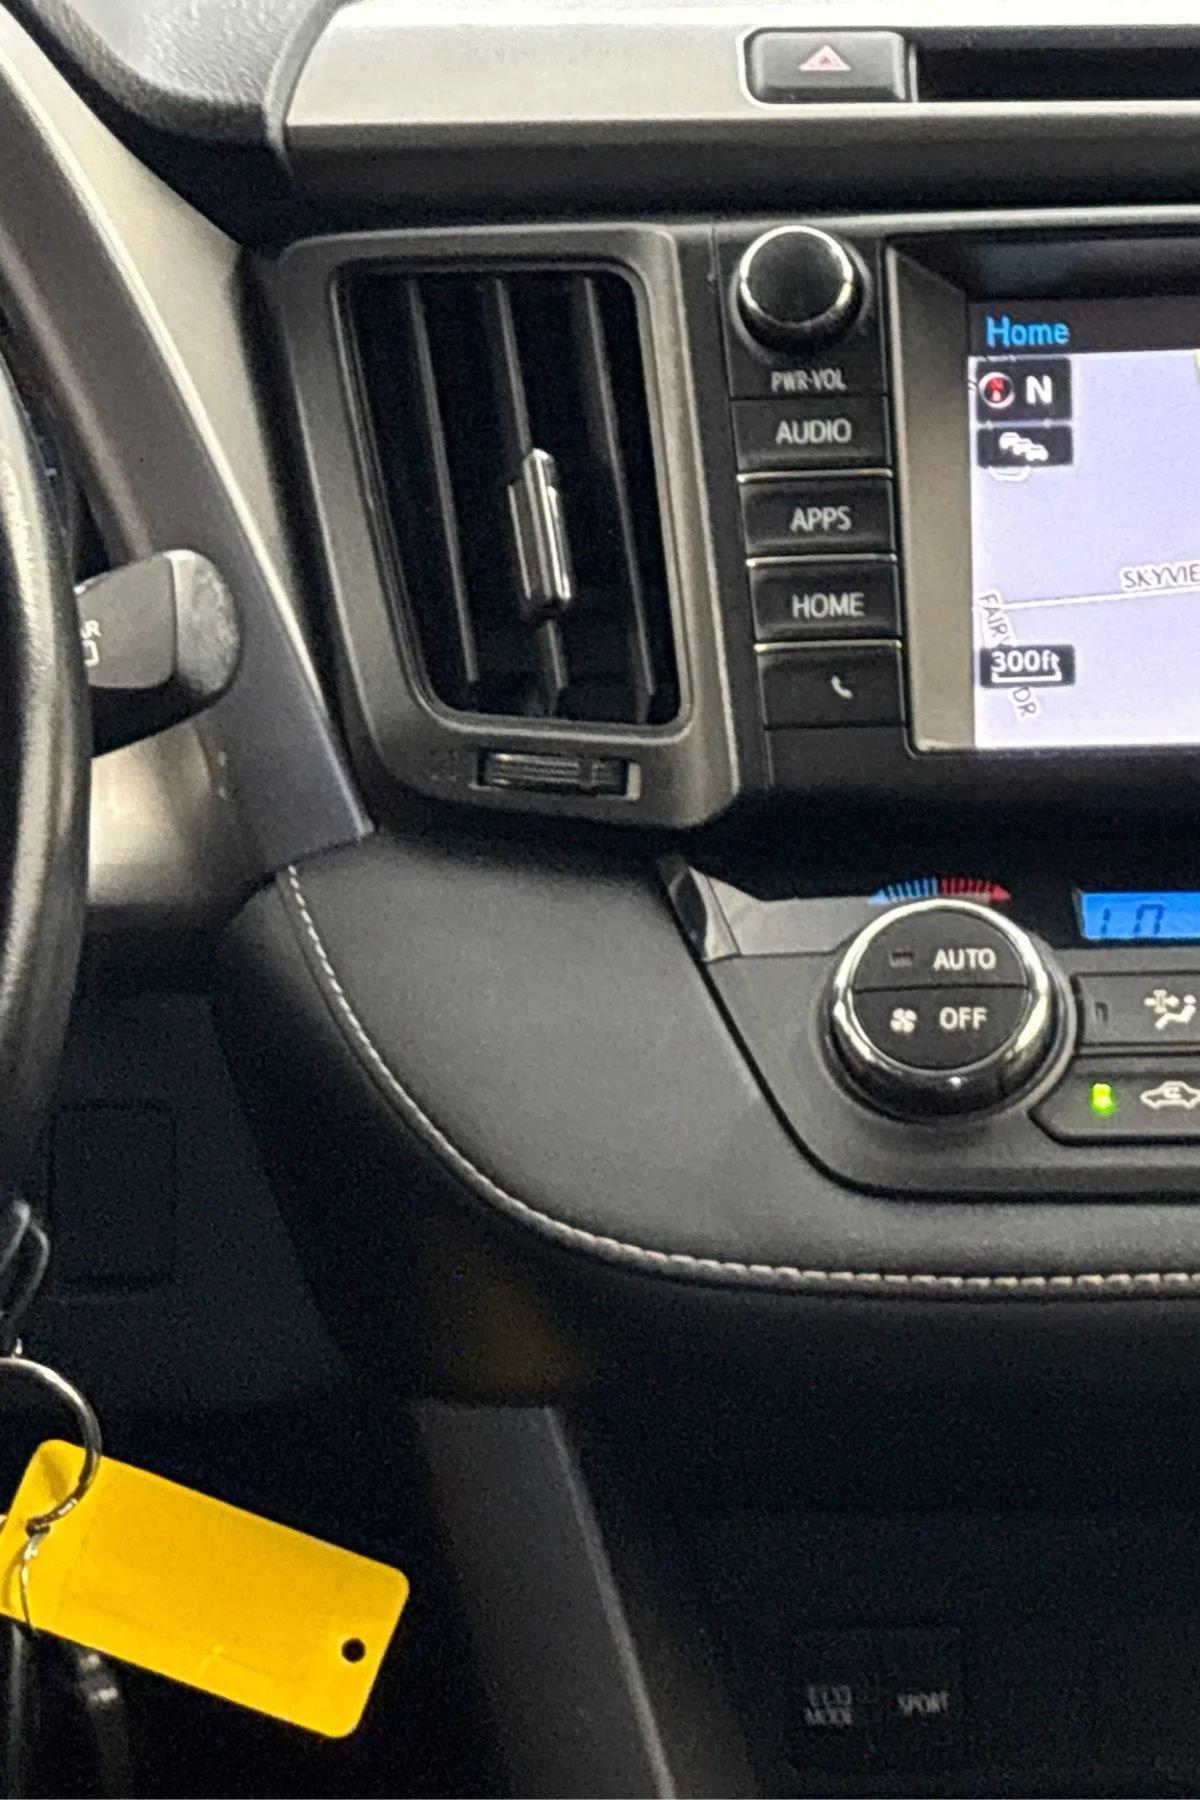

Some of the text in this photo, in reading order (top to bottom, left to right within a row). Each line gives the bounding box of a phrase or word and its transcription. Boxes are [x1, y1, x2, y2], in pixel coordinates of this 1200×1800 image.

[985, 316, 1069, 348] Home
[1026, 374, 1052, 405] N
[775, 418, 851, 445] AUDIO
[790, 506, 851, 533] APPS
[792, 593, 864, 619] HOME
[991, 648, 1061, 673] 300ft
[932, 948, 996, 971] AUTO
[939, 1006, 988, 1030] OFF
